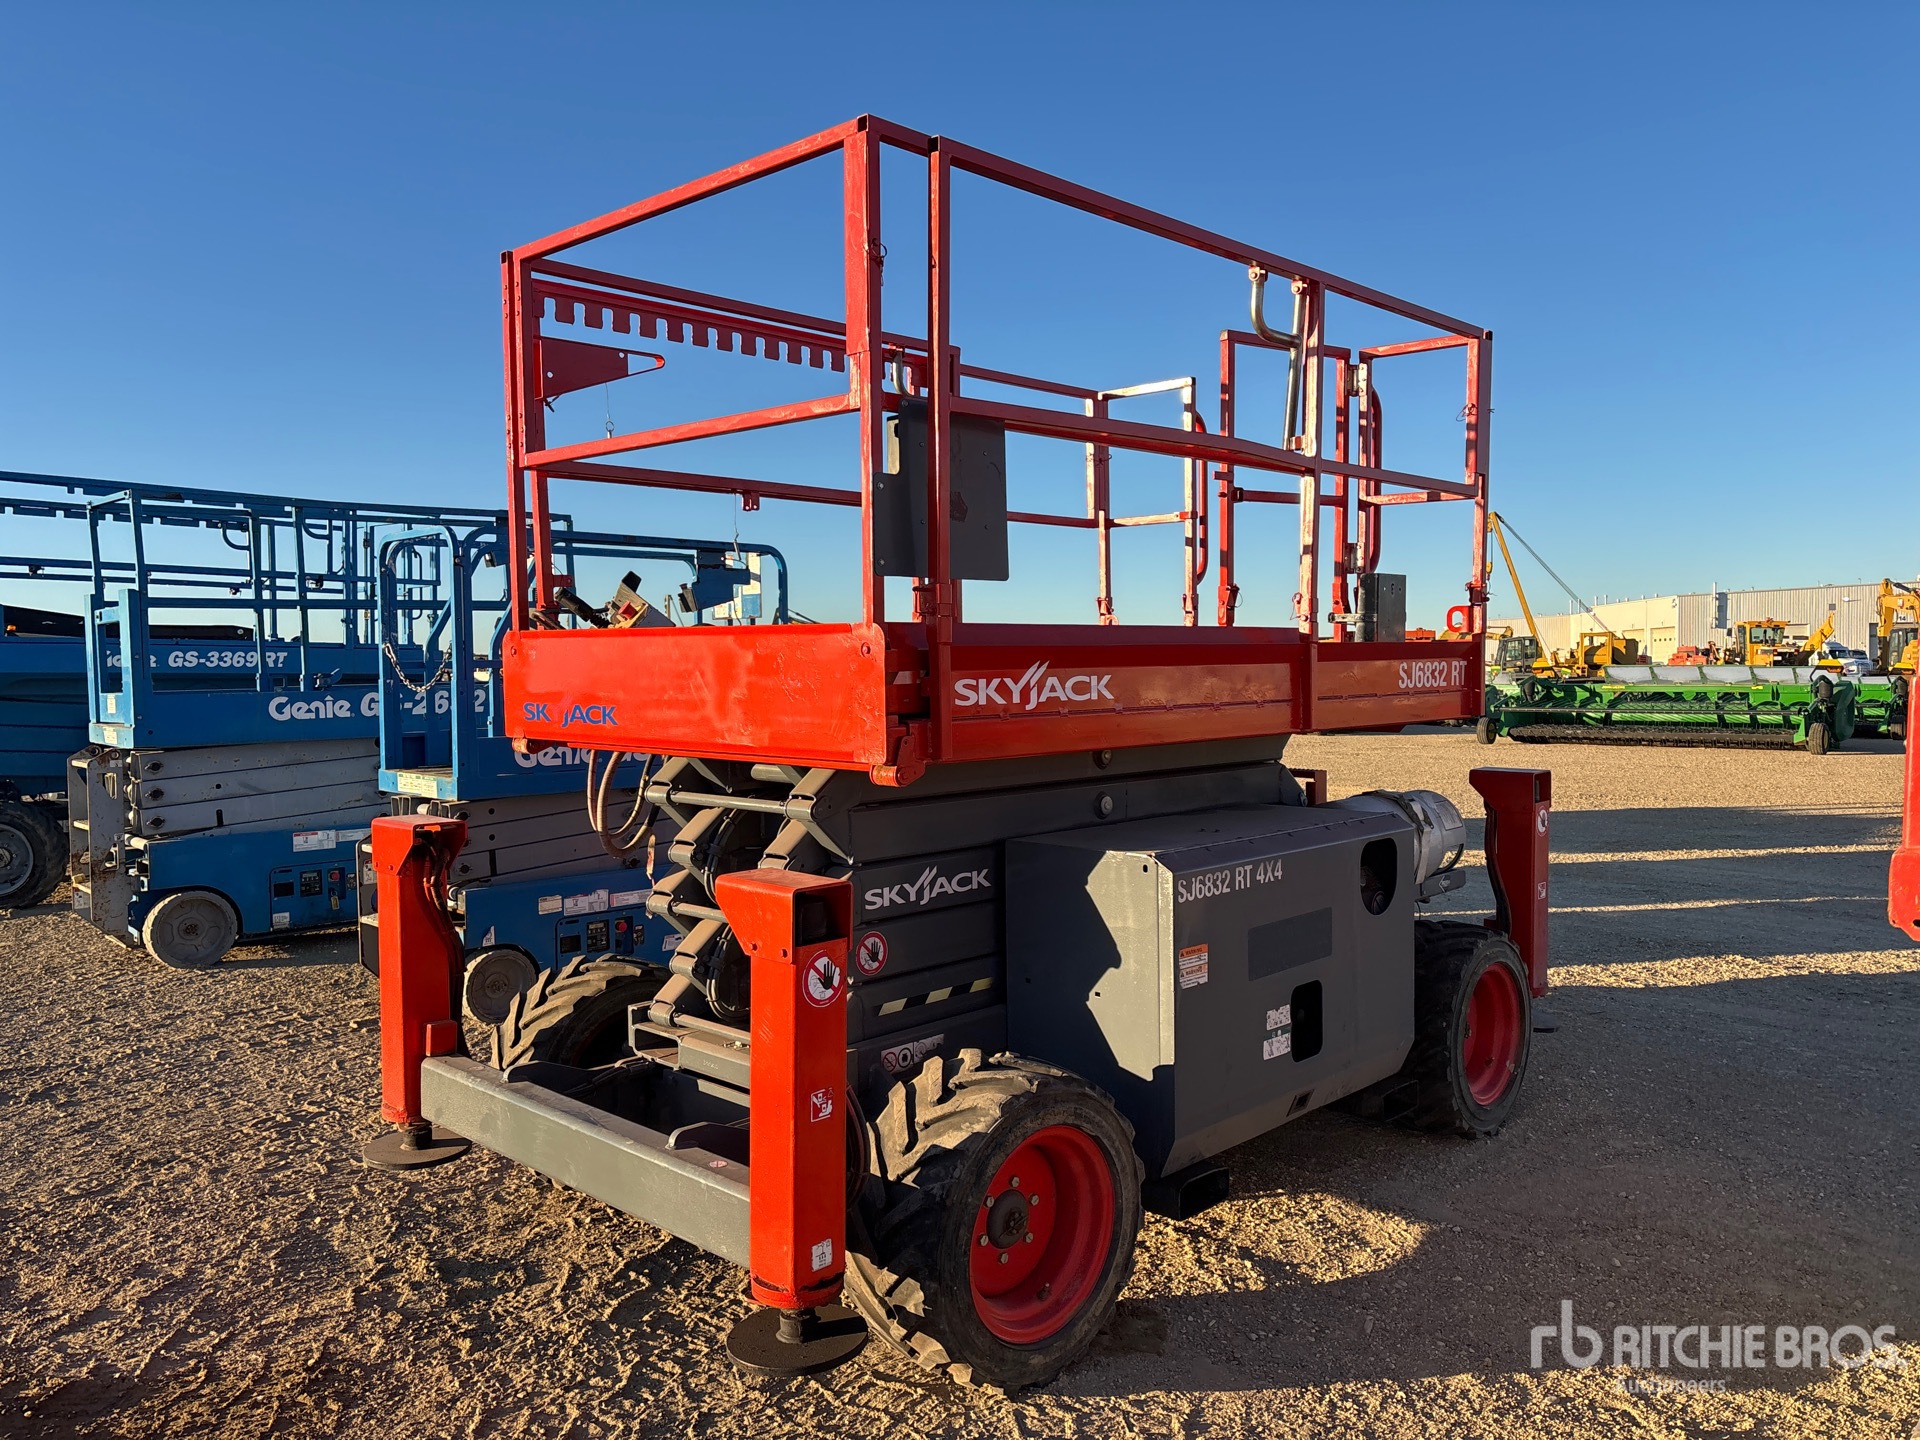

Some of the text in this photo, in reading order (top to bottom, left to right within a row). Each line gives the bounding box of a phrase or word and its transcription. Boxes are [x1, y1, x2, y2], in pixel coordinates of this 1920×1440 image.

[168, 651, 258, 667] GS-3369
[265, 652, 288, 668] RT
[1399, 660, 1467, 688] SJ6832 RT
[954, 660, 1114, 711] SKYJACK
[268, 689, 487, 721] Genie G-262
[864, 865, 992, 910] SKYJACK
[1178, 859, 1282, 903] SJ6832 RT 4X4
